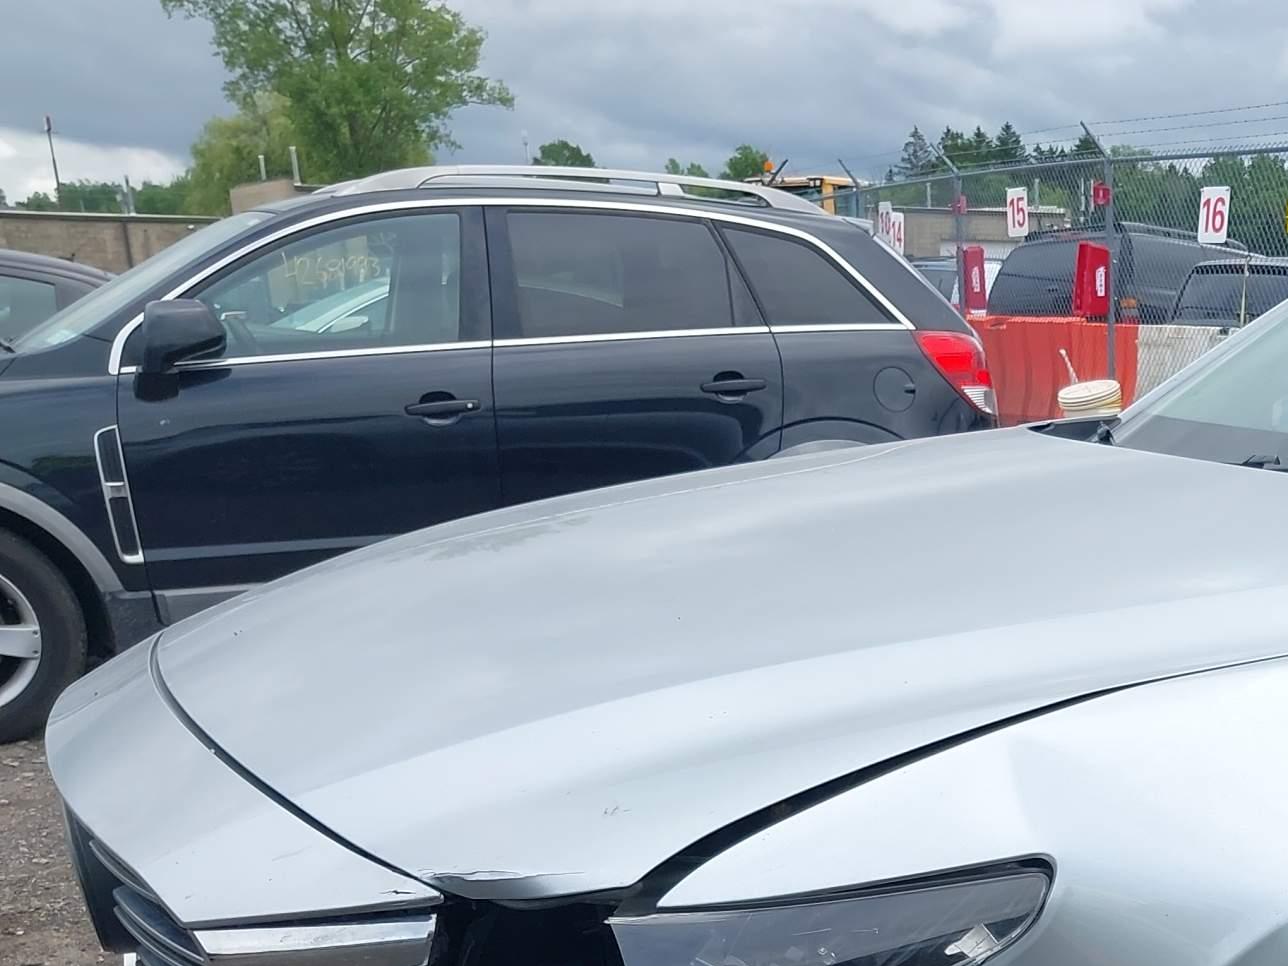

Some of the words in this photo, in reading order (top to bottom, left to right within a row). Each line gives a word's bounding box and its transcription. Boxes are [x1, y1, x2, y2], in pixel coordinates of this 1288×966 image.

[1008, 196, 1026, 229] 15
[1202, 197, 1226, 233] 16
[892, 221, 902, 248] 14
